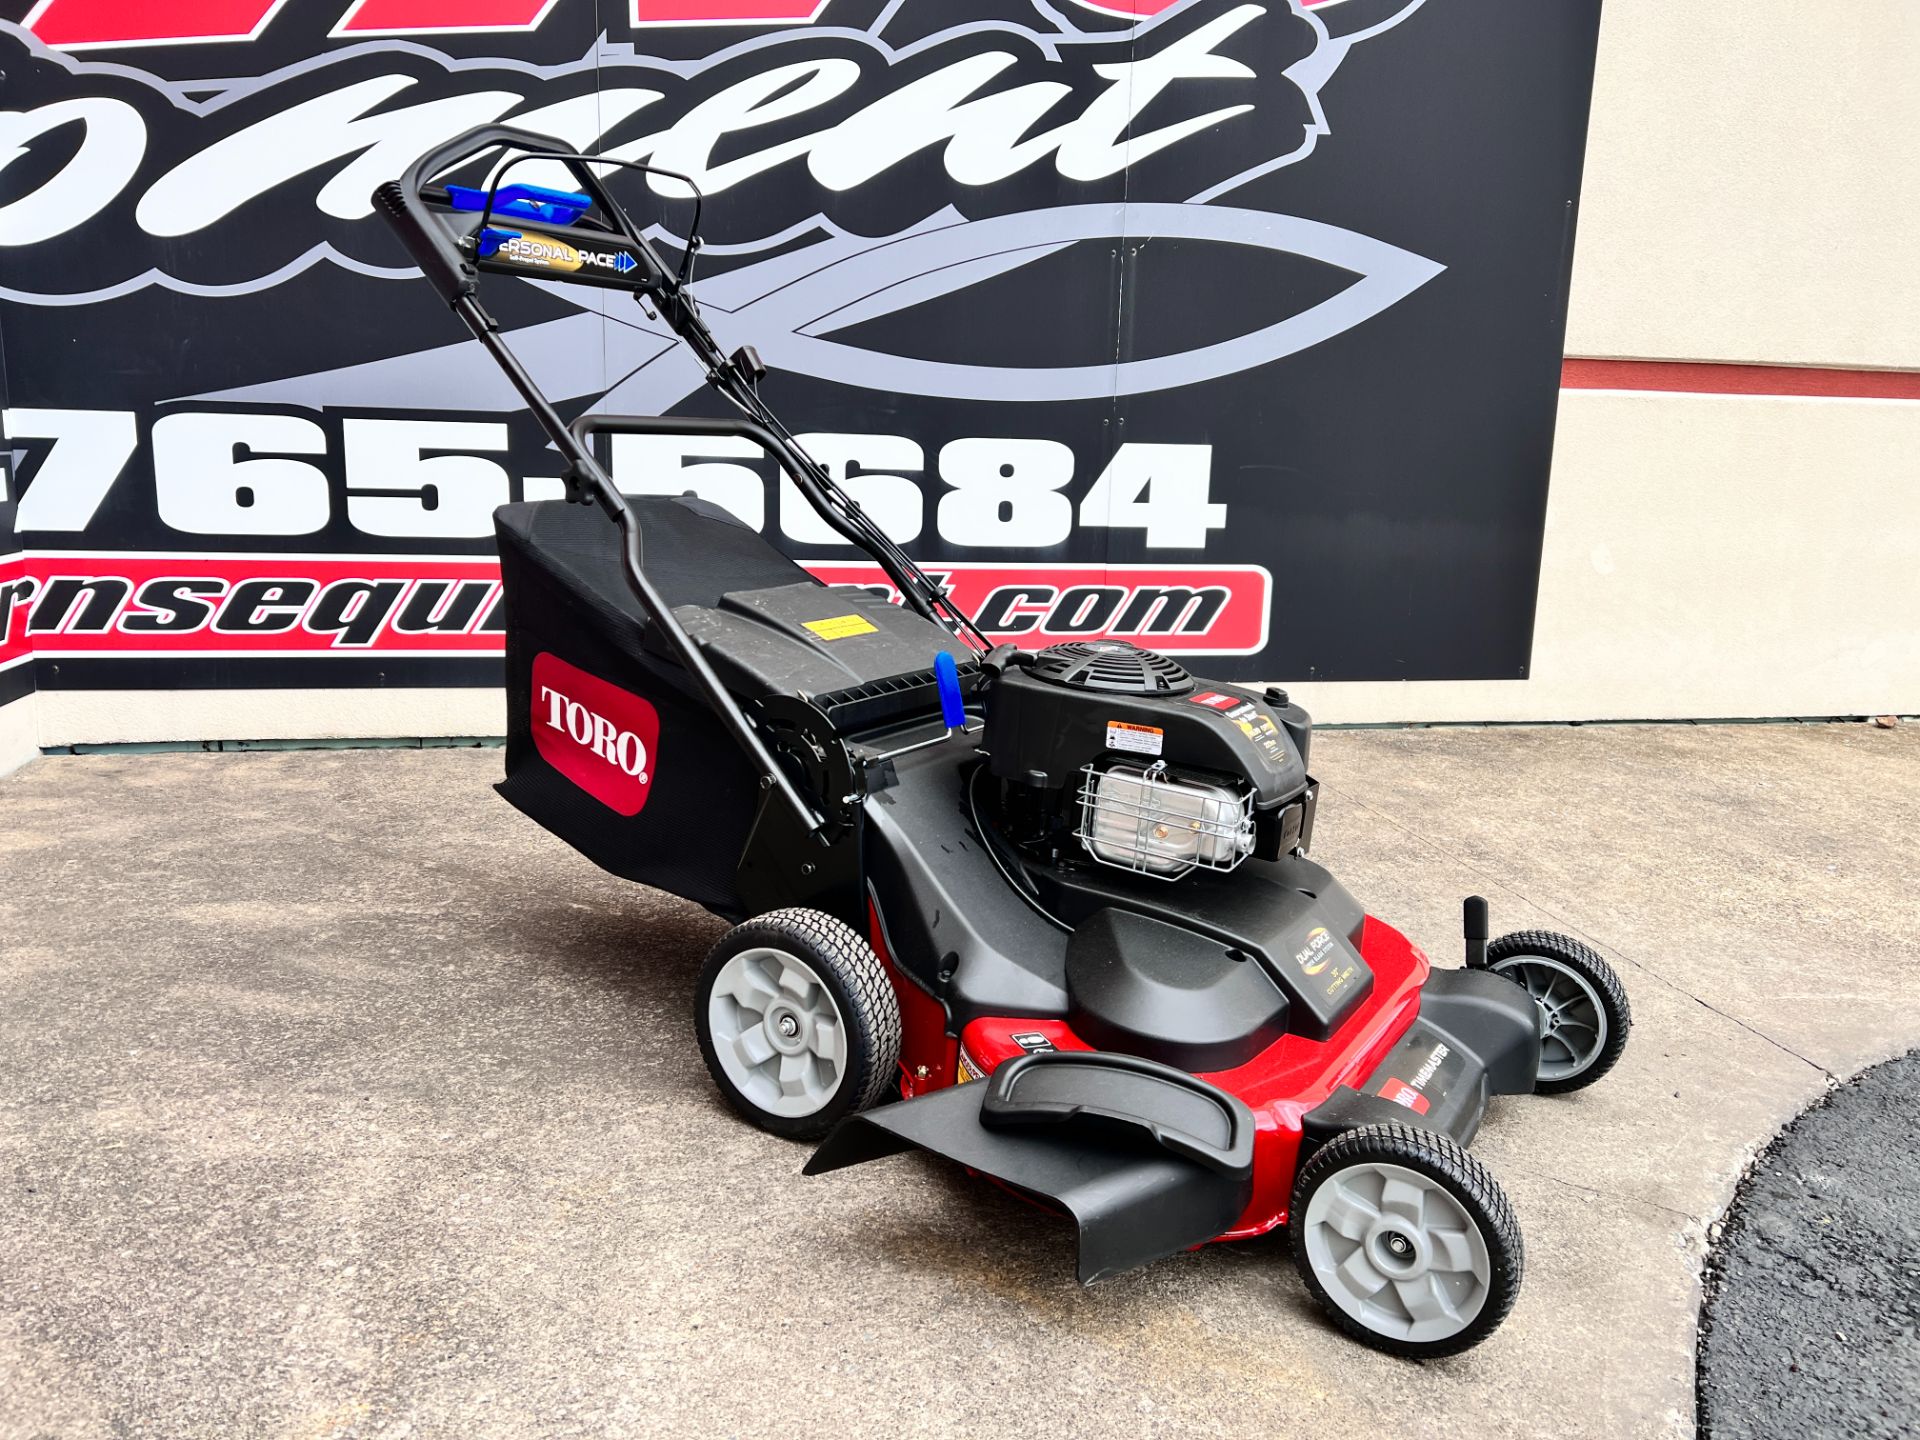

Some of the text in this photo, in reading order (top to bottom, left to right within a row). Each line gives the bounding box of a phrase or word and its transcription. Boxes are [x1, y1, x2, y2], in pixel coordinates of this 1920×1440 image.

[499, 237, 616, 268] ERSONAL PACE
[1127, 725, 1155, 734] WARNING
[1295, 930, 1331, 965] DUAL FORCE
[1410, 1042, 1451, 1091] TIMEMASTER
